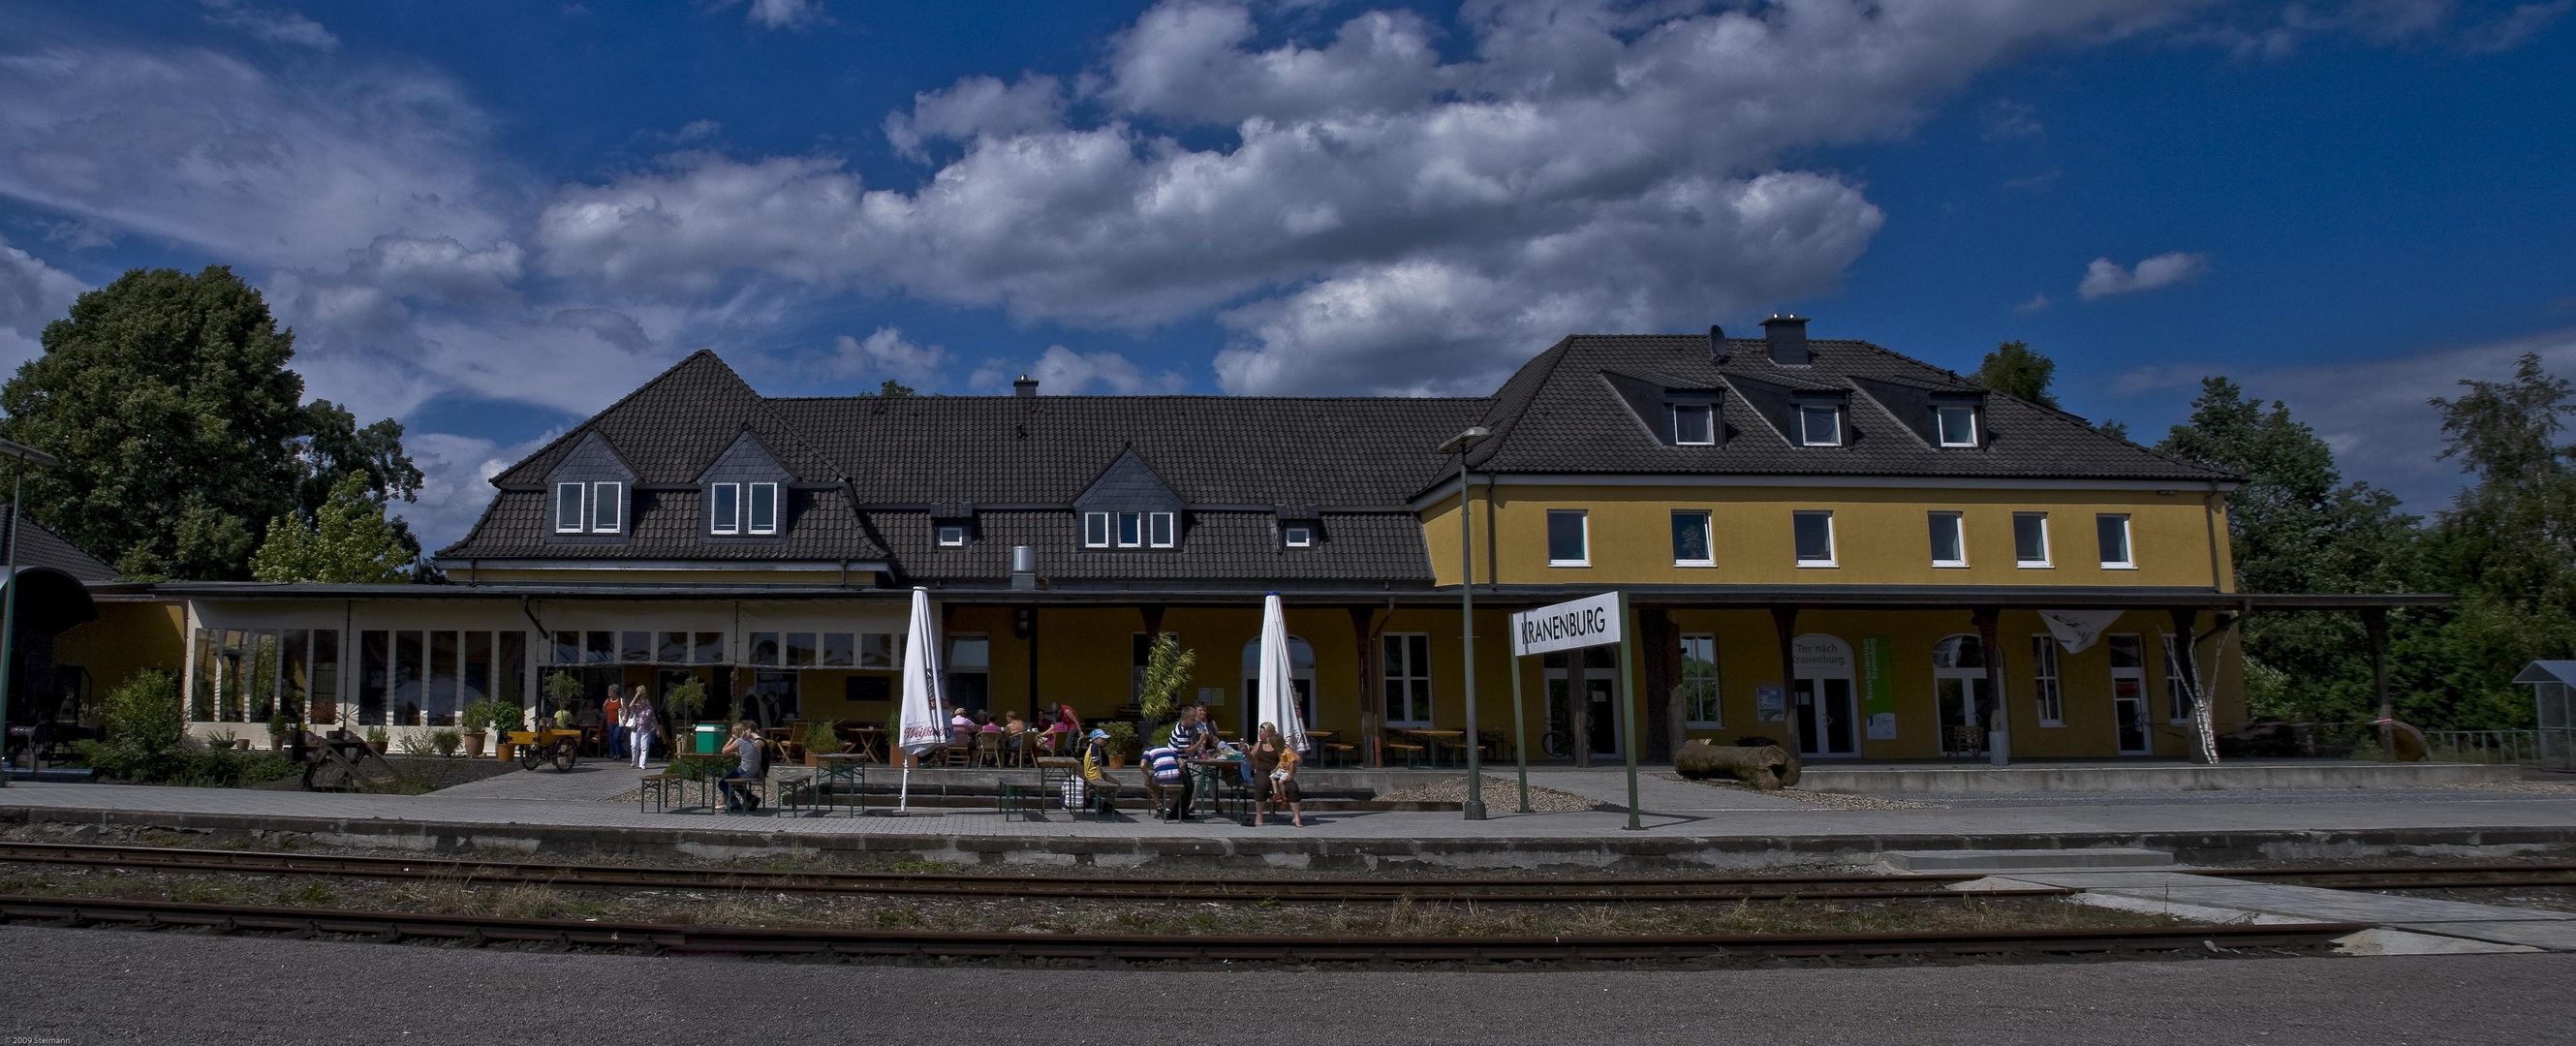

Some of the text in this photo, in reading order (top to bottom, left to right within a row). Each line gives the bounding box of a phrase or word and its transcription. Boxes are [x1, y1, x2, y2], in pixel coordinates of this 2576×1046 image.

[1521, 606, 1605, 645] KRANENBURG
[1795, 643, 1838, 653] Tor nach
[1869, 638, 1878, 680] Kranenburg
[1863, 638, 1874, 699] Besucherzentrum
